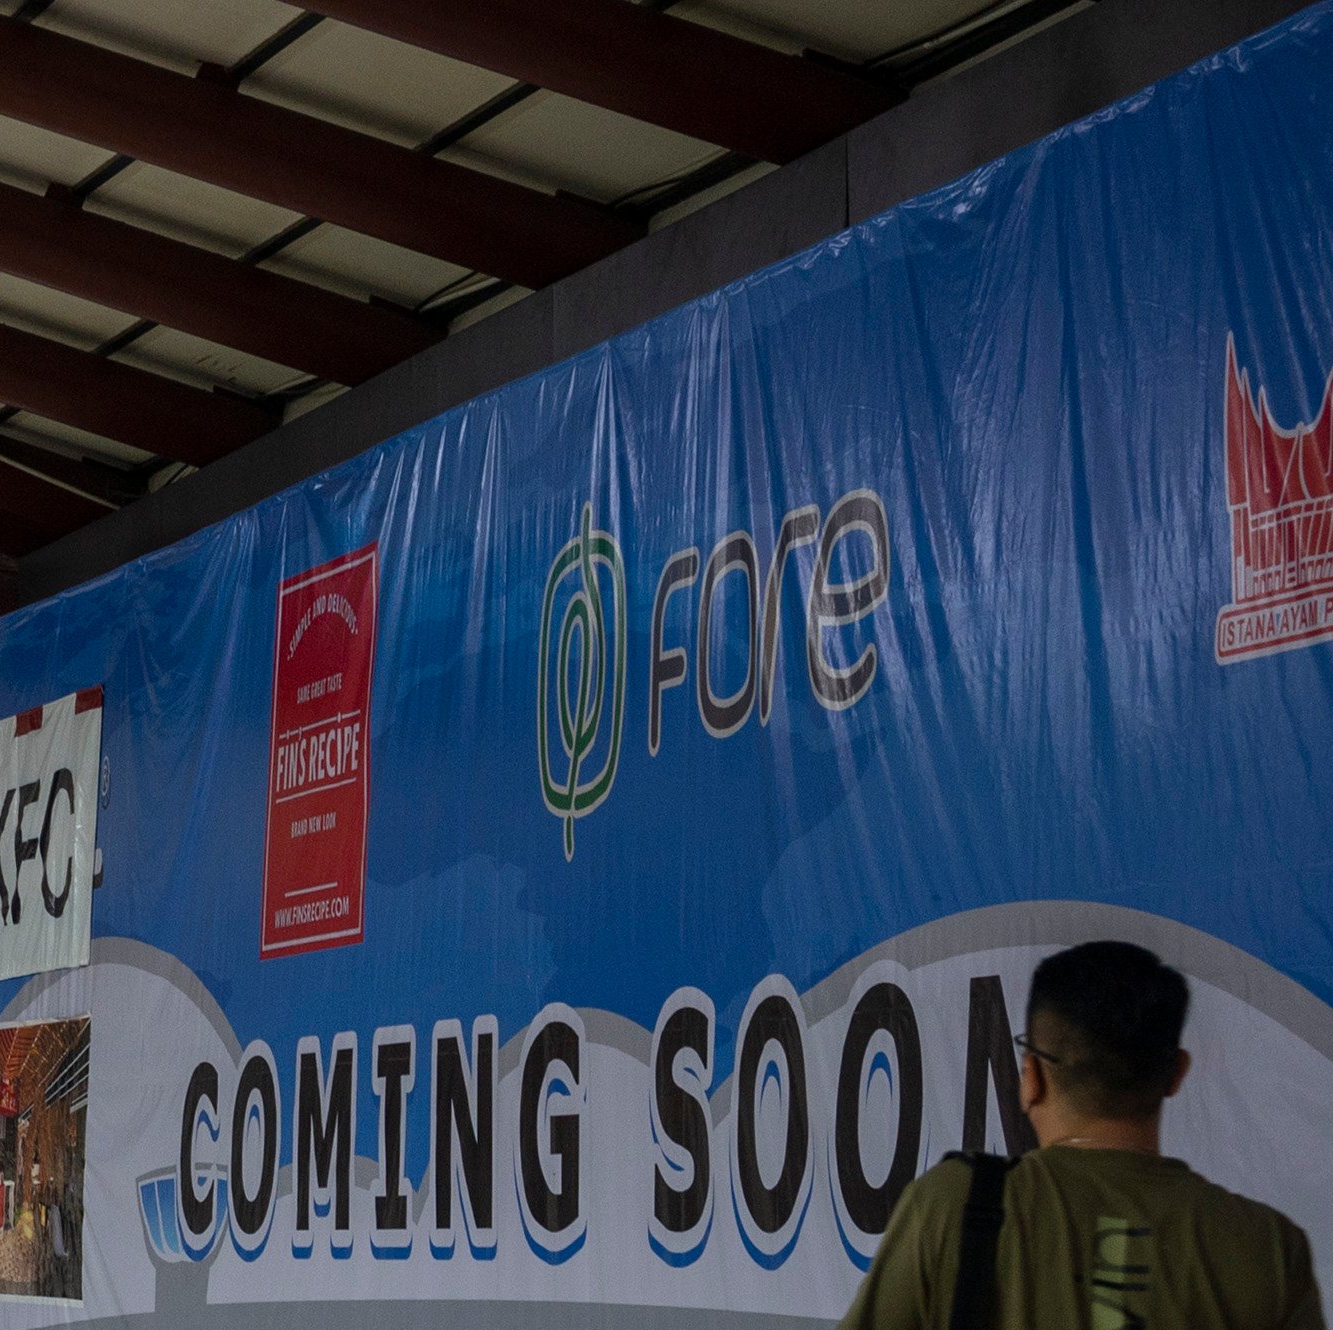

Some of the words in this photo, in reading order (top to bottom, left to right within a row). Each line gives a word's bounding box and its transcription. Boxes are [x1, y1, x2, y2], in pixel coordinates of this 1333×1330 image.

[313, 595, 327, 620] AND
[647, 488, 890, 757] fore
[1221, 612, 1276, 648] ISTANA
[1280, 603, 1318, 634] AYAM
[297, 683, 311, 705] SAME
[311, 677, 327, 700] GREAT
[327, 672, 342, 693] TASTE
[308, 723, 360, 783] RECIPE
[308, 814, 322, 834] NEW
[322, 811, 337, 831] LOOK
[274, 895, 350, 929] WWW.FINSRECIPE.COM
[179, 1018, 583, 1236] COMING
